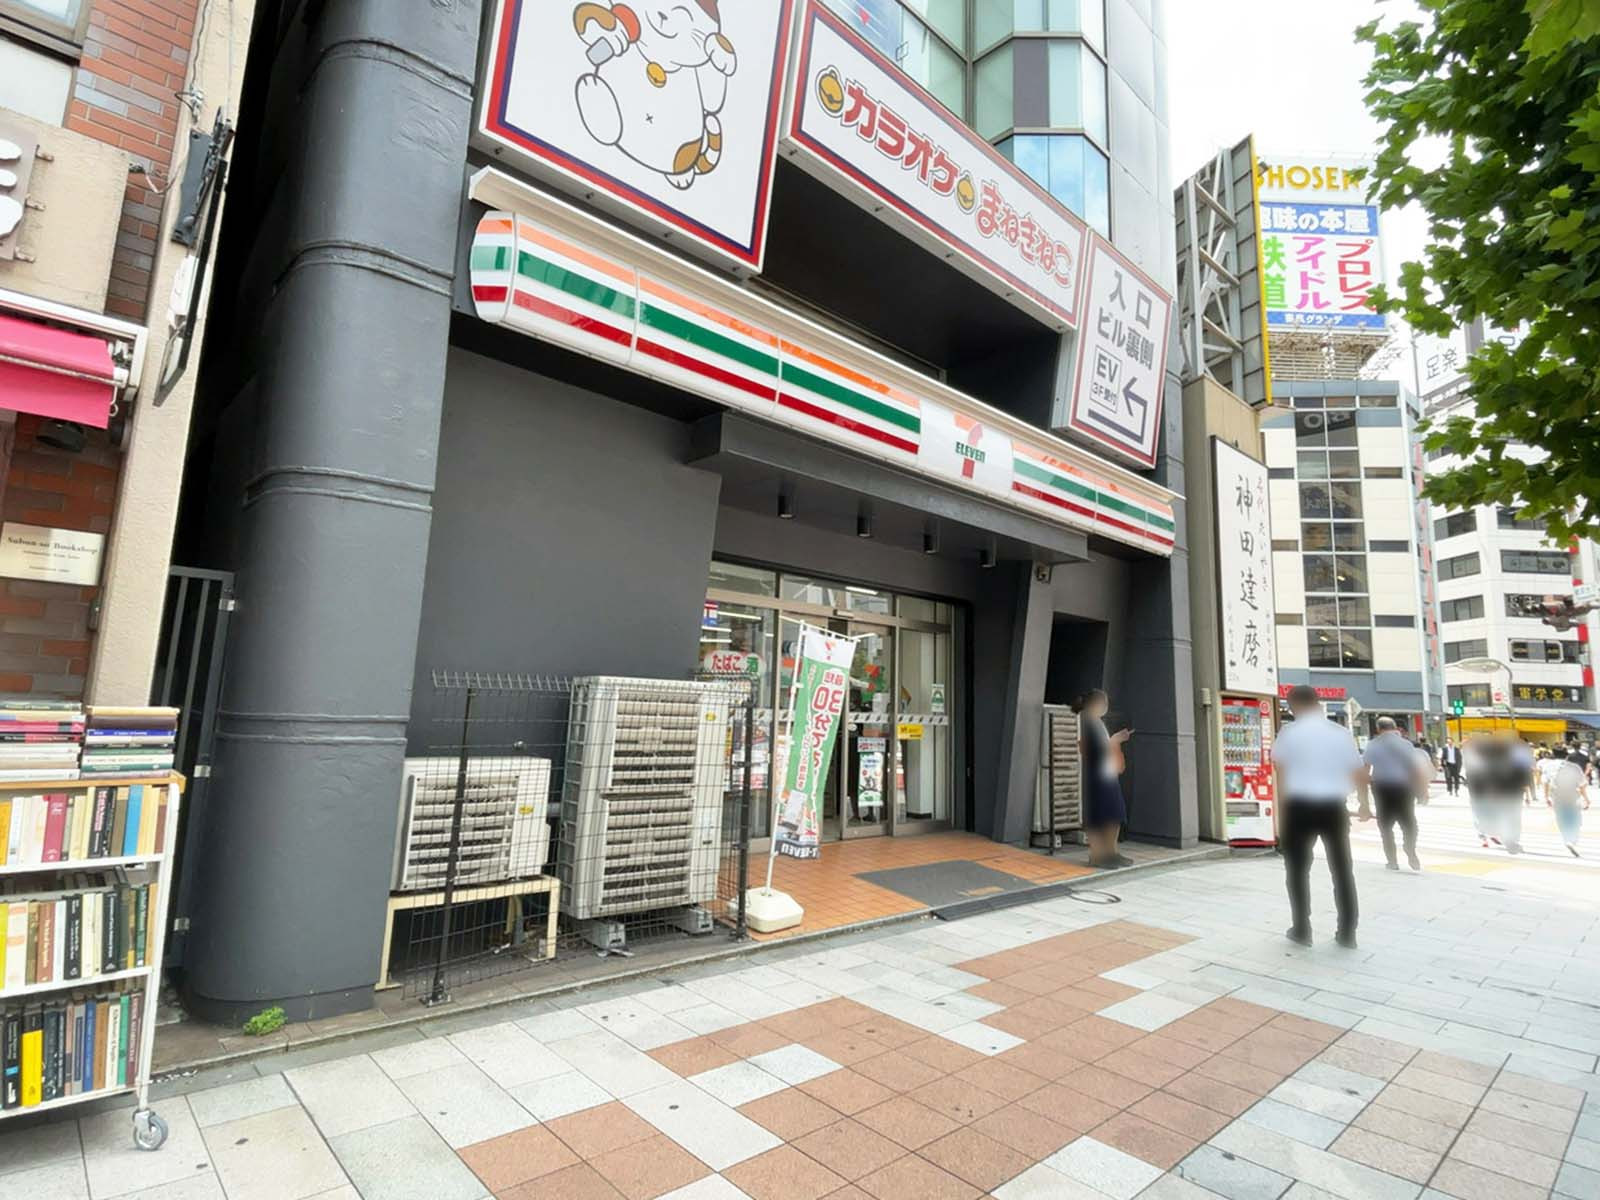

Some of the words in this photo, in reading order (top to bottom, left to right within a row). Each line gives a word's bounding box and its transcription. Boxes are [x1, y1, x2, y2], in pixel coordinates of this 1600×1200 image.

[841, 79, 960, 197] カラオケ
[976, 178, 1073, 287] まねきねこ
[1109, 270, 1152, 330] 入口
[1293, 236, 1331, 310] アイドル
[1336, 238, 1377, 312] プロレス
[1097, 355, 1119, 384] EV
[1235, 474, 1261, 668] 神田達磨
[711, 653, 741, 671] たばこ
